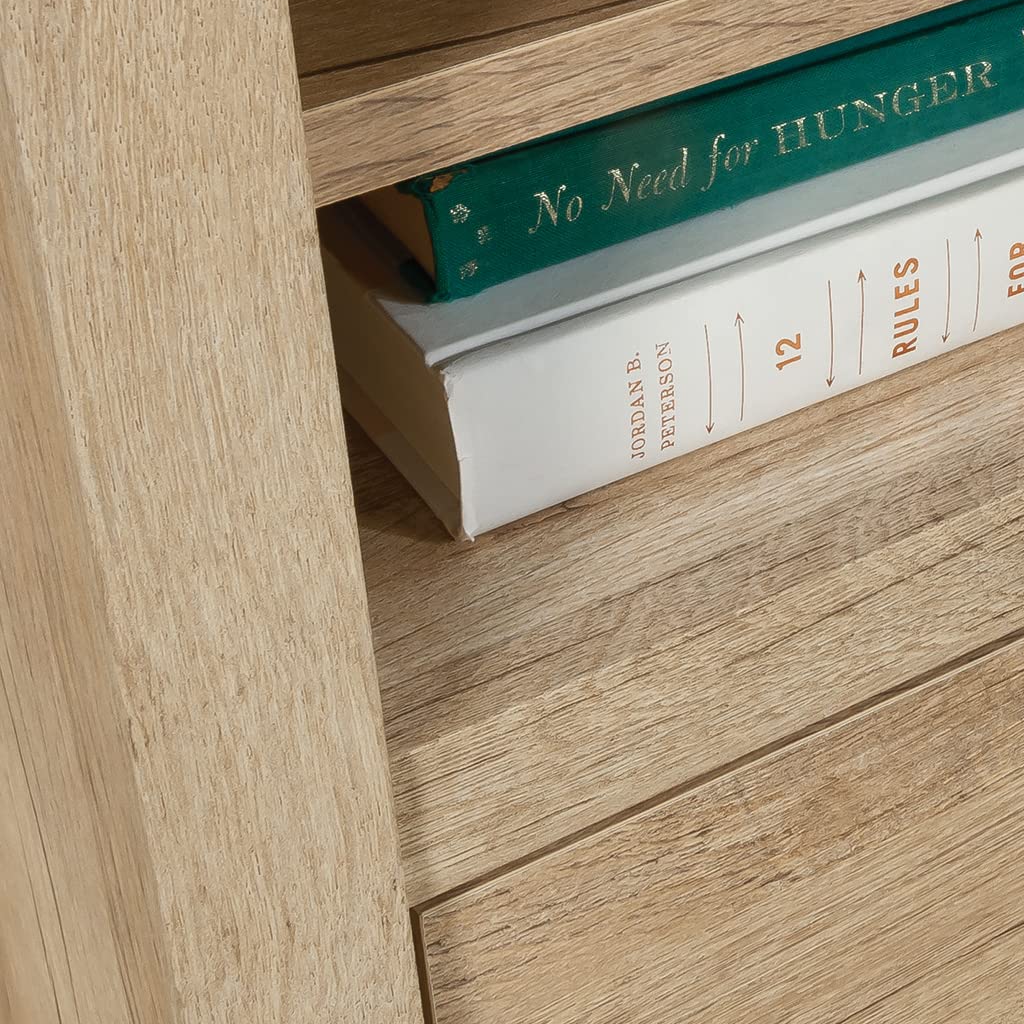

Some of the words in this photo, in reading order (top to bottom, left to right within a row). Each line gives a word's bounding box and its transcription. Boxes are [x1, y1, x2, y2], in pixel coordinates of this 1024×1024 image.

[528, 184, 583, 234] No
[601, 147, 690, 211] Need
[701, 133, 759, 192] for
[771, 60, 998, 158] HUNGER
[776, 333, 801, 371] 12
[891, 256, 920, 358] RULES
[626, 351, 642, 374] B.
[655, 341, 676, 451] PETERSON
[627, 380, 645, 460] JORDAN
